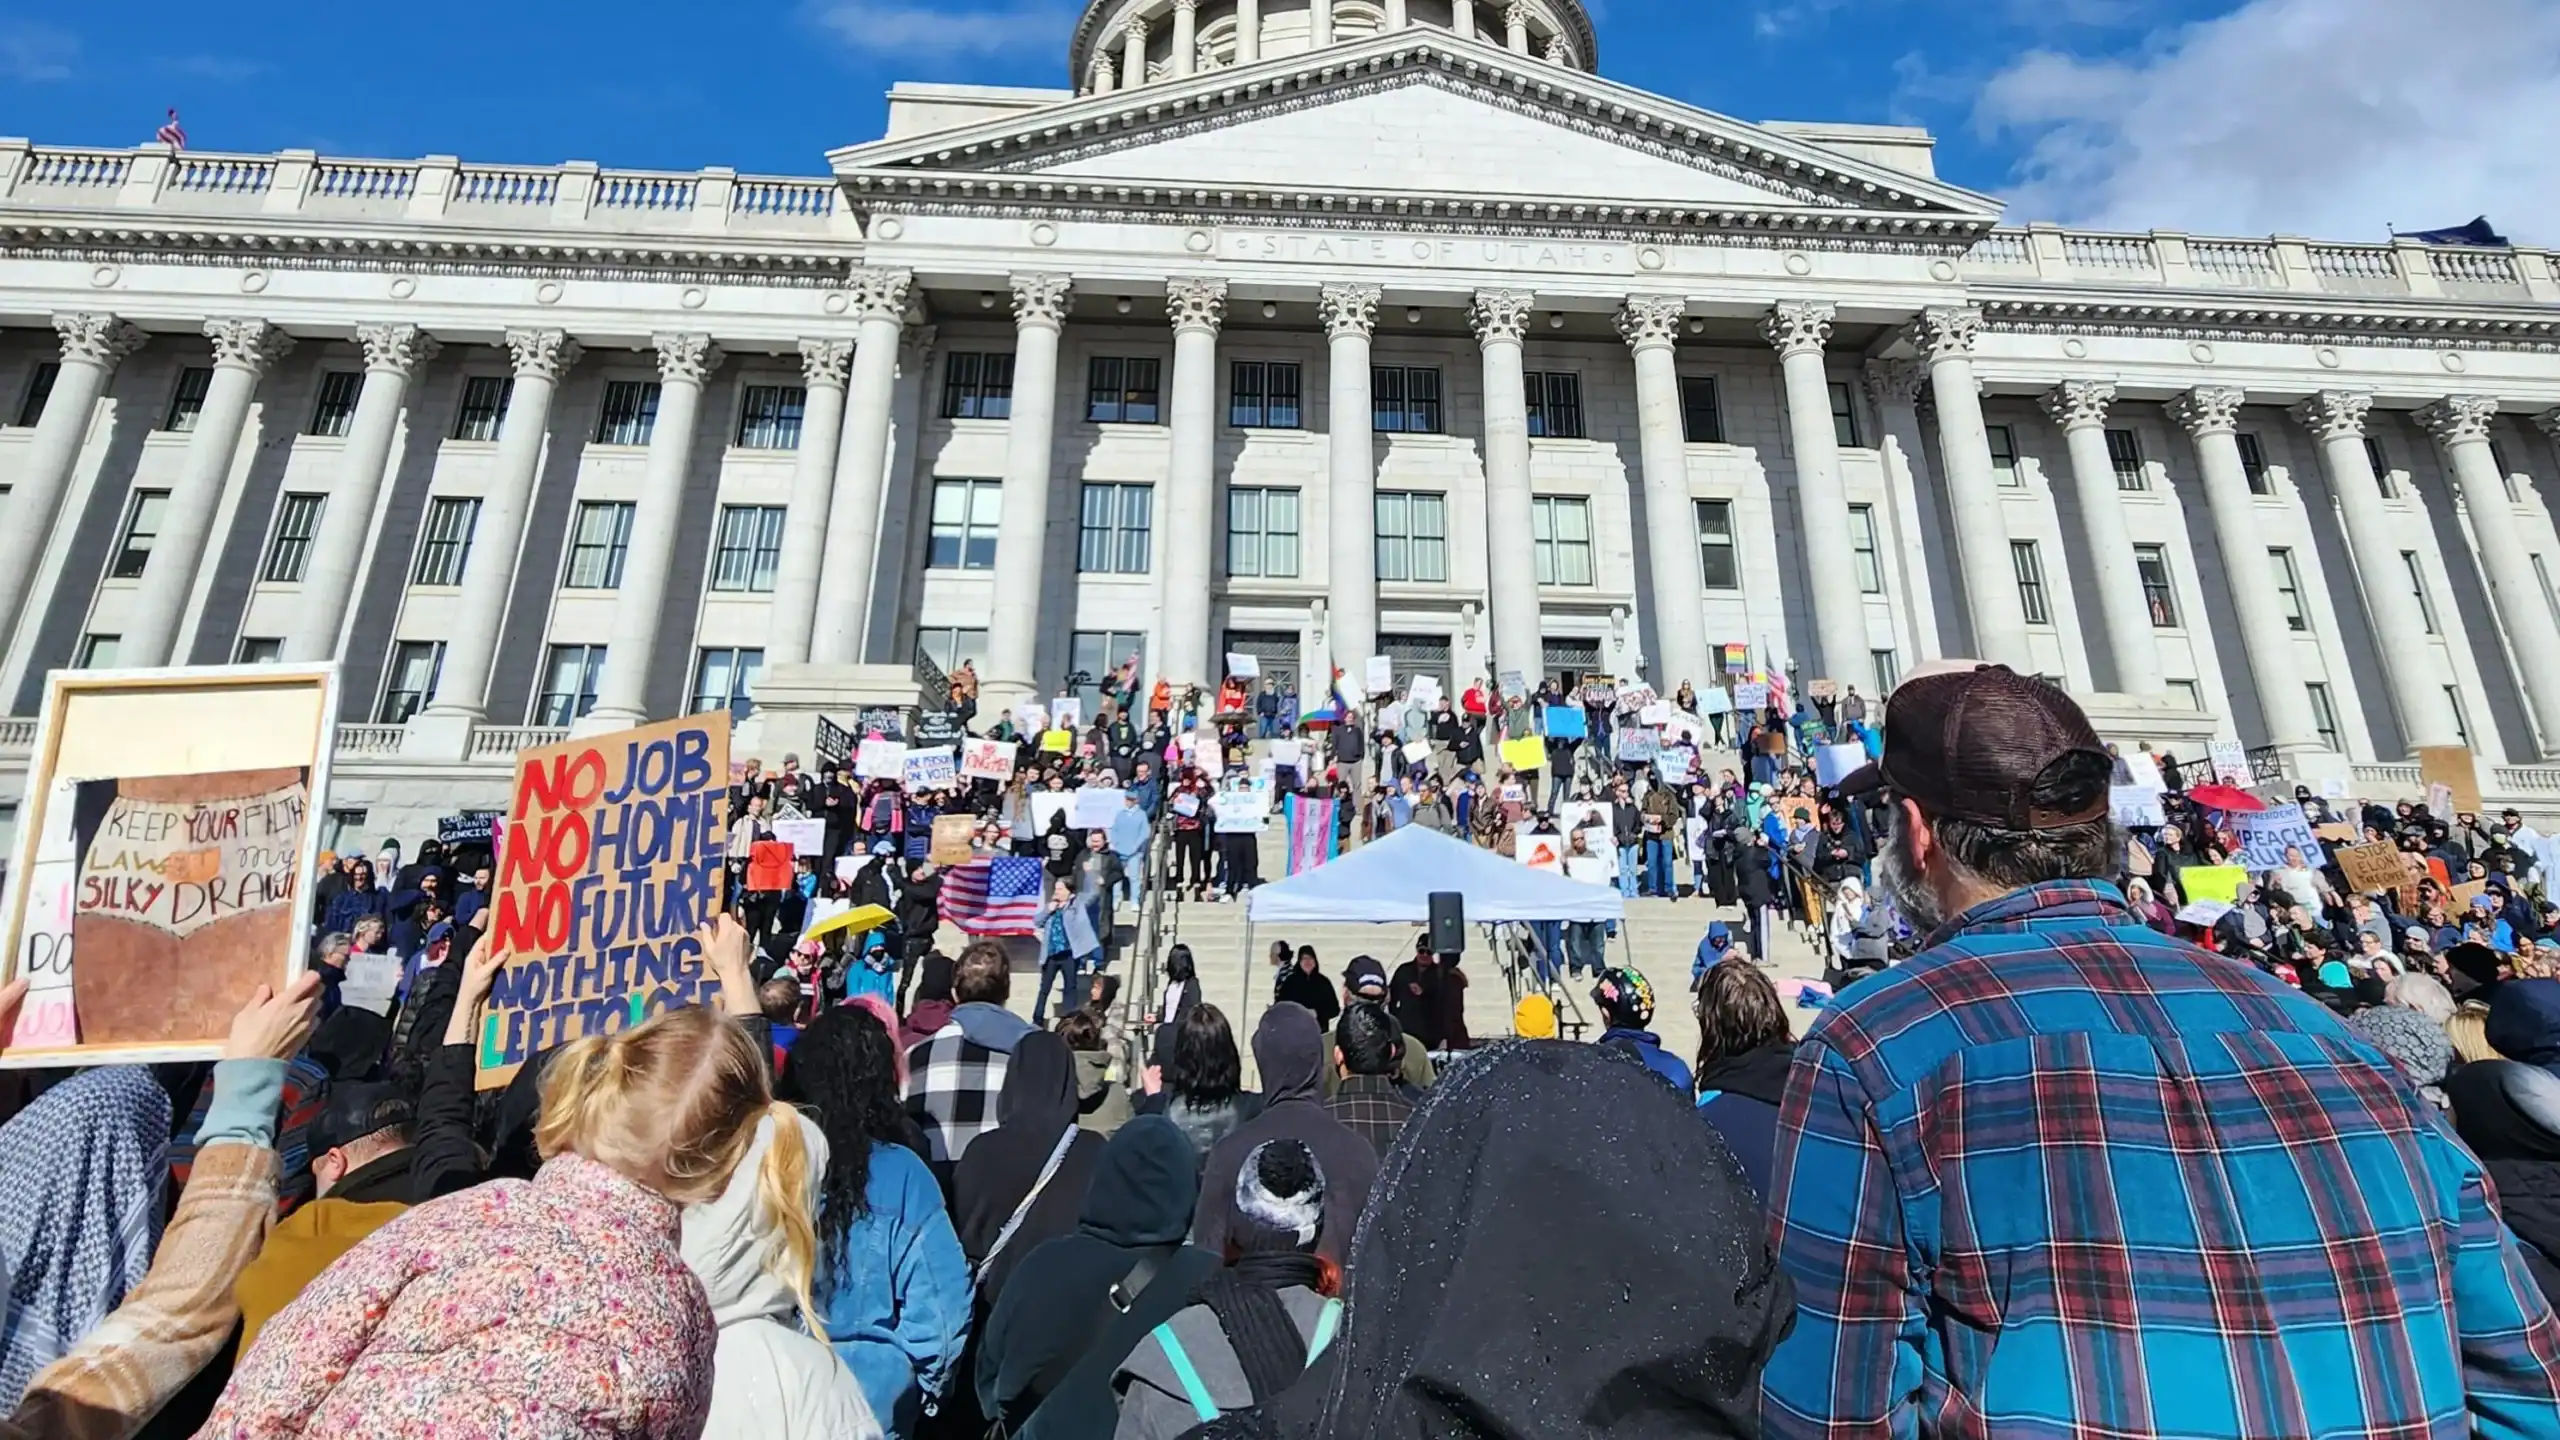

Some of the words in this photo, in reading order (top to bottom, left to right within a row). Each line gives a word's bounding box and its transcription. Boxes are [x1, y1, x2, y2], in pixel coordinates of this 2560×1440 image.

[1262, 236, 1385, 259] STATE
[1411, 240, 1453, 261] OF
[1482, 243, 1587, 264] UTAH
[513, 748, 607, 822] NO
[604, 728, 711, 804] JOB
[905, 757, 921, 769] ONE
[923, 755, 953, 768] PERSON
[906, 771, 925, 782] ONE
[925, 767, 954, 781] VOTE
[108, 806, 178, 842] KEEP
[183, 807, 239, 843] YOUR
[244, 796, 304, 836] FILTH
[457, 820, 488, 830] FUND
[2248, 807, 2297, 820] PRESIDENT
[500, 810, 590, 888] NO
[588, 789, 726, 874] HOME
[2354, 842, 2388, 859] STOP
[79, 875, 164, 914] SILKY
[491, 880, 571, 958] NO
[568, 857, 724, 953] FUTURE
[488, 936, 704, 1010] NOTHING
[480, 1002, 577, 1069] LEFT
